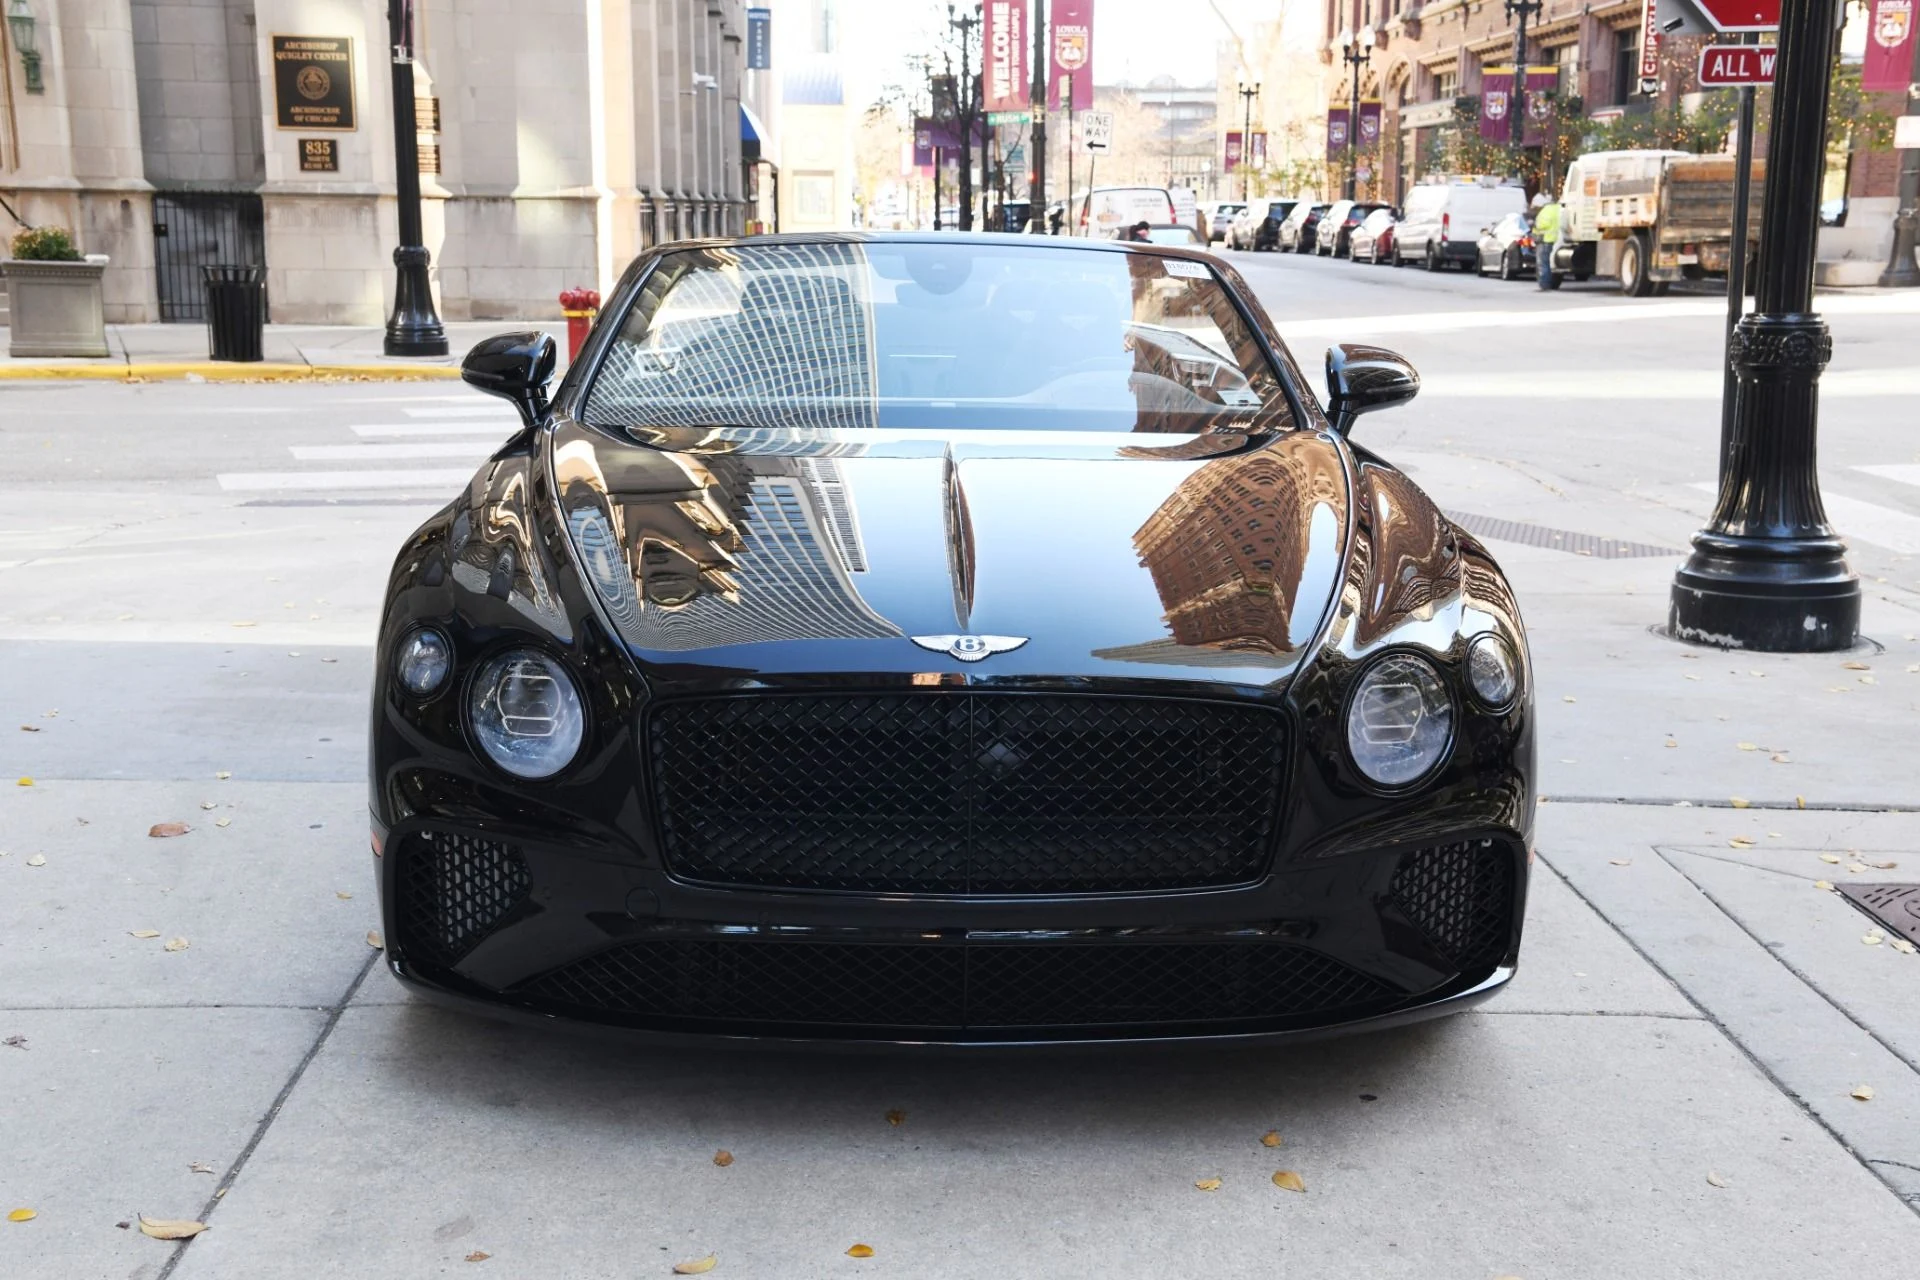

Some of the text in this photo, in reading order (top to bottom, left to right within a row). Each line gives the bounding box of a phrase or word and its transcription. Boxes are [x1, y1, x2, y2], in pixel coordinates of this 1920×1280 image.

[1011, 8, 1020, 39] CAMPUS
[1055, 25, 1089, 34] LOYOLA
[283, 41, 339, 50] ARCHBISHOP
[992, 2, 1010, 99] WELCOME
[276, 51, 348, 61] QUIGLEY CENTER
[1011, 40, 1020, 66] TOWER
[1711, 54, 1777, 77] ALL W
[1086, 115, 1110, 126] ONE
[1085, 127, 1109, 138] WAY
[305, 141, 331, 155] 835
